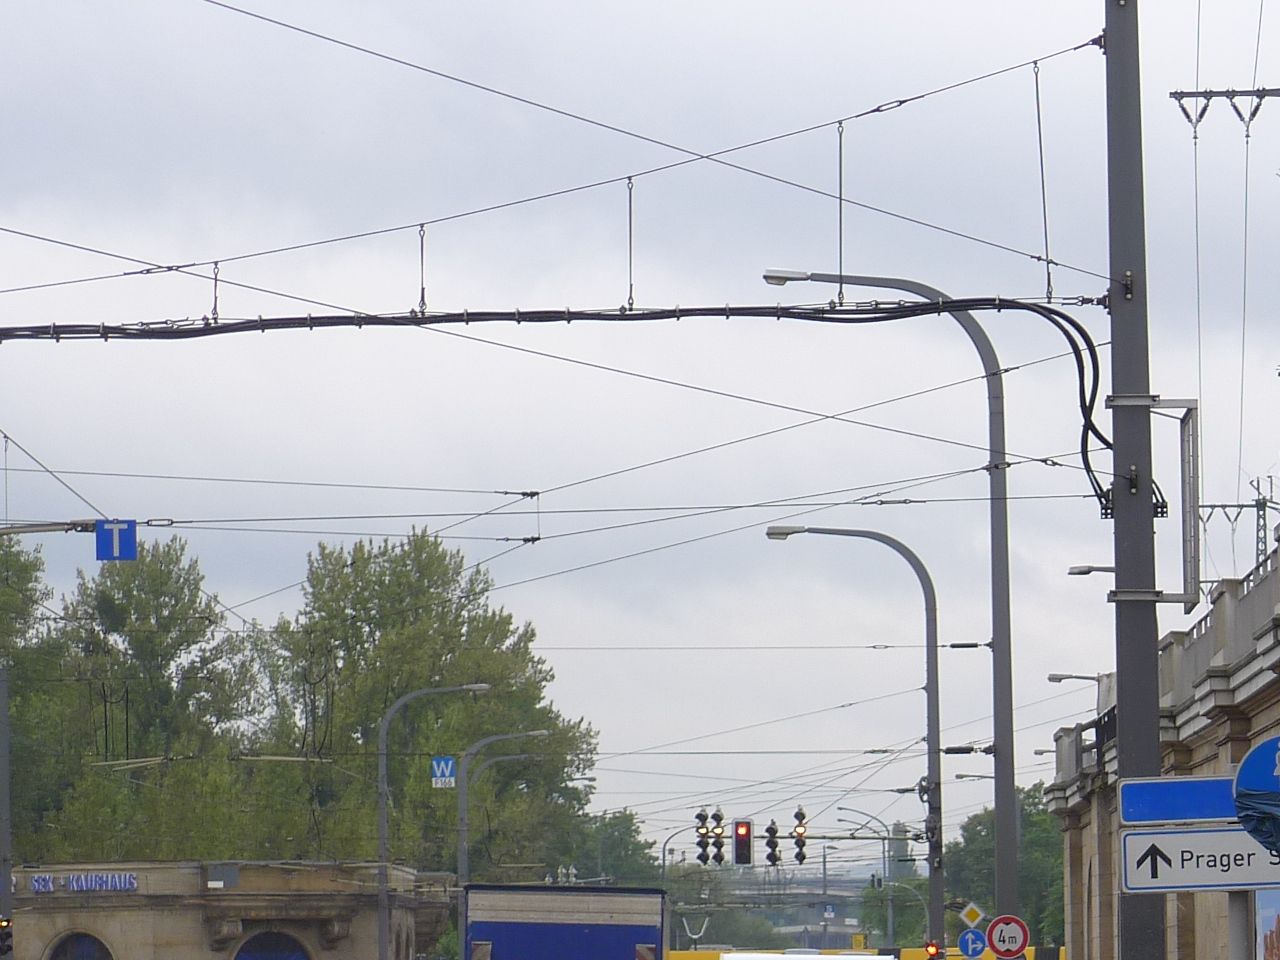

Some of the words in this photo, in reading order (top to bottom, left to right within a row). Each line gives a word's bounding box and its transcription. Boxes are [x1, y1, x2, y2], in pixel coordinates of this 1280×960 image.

[432, 760, 453, 777] W
[1181, 850, 1256, 872] Prager
[69, 873, 138, 891] KAUFHAUS
